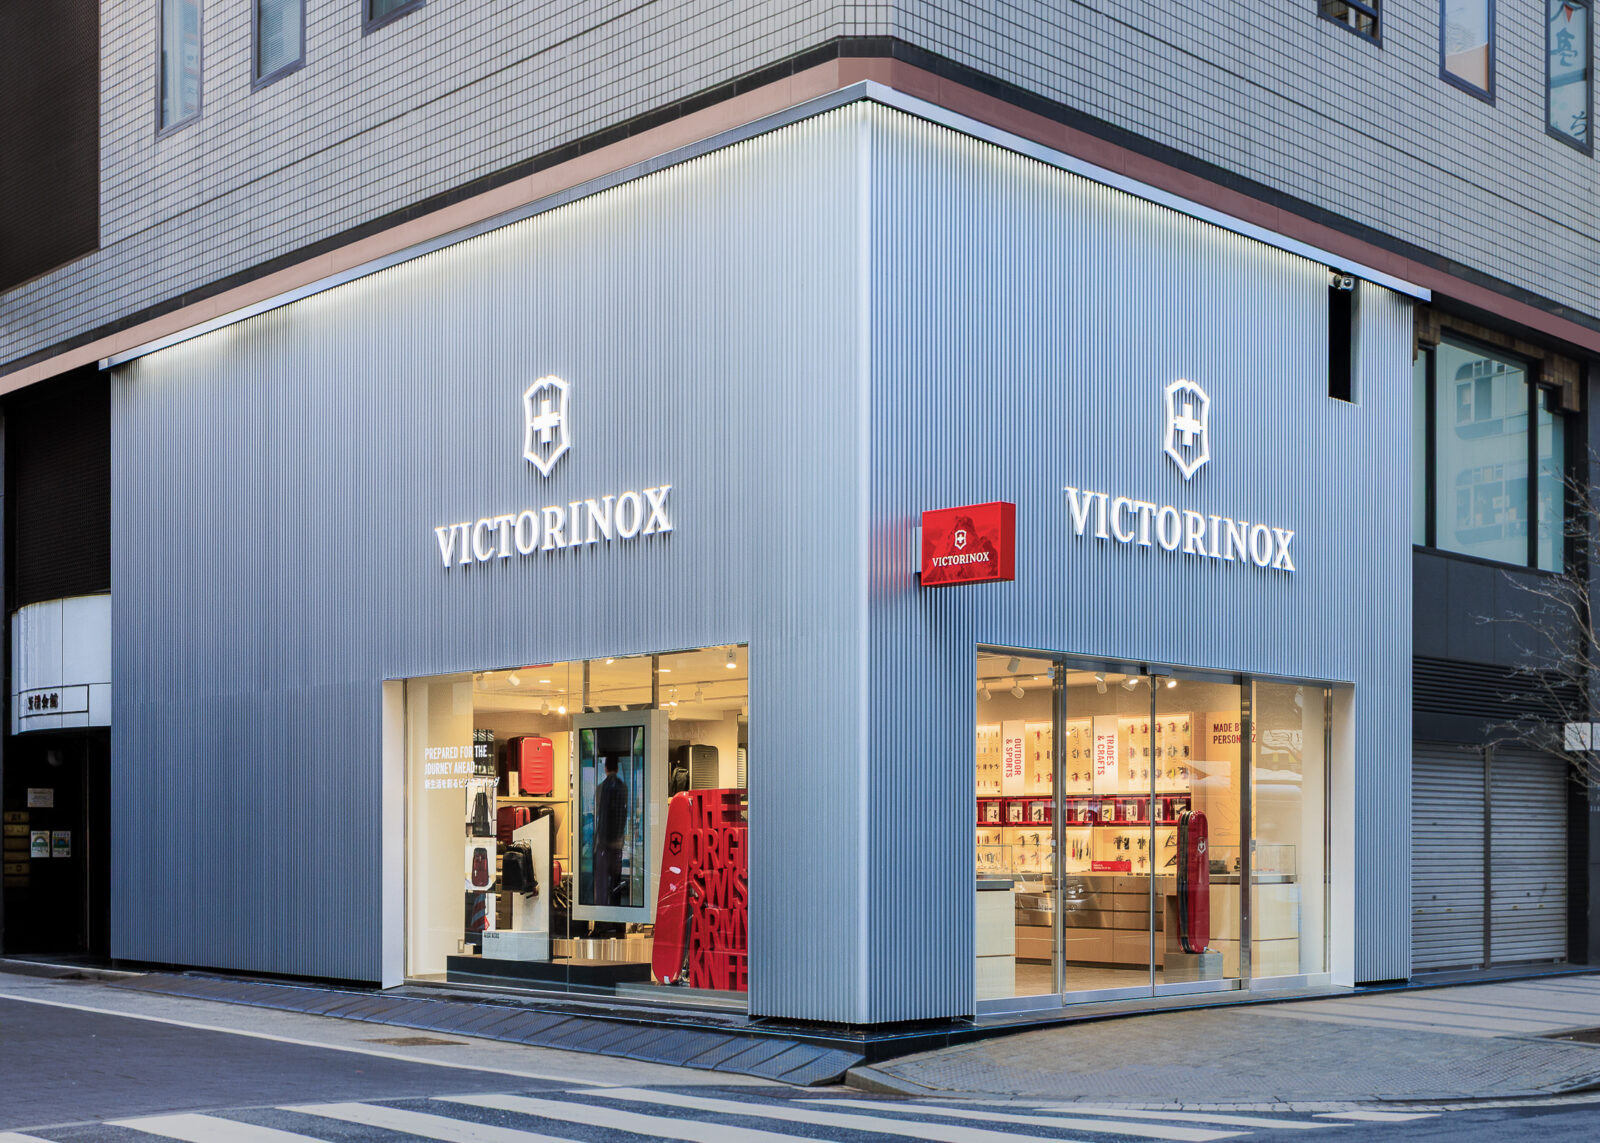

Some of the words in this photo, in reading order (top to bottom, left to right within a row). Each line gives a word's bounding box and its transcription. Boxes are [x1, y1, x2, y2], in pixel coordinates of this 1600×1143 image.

[434, 484, 674, 568] VICTORINOX
[1063, 486, 1295, 572] VICTORINOX
[932, 551, 990, 568] VICTORINOX
[1213, 722, 1233, 733] MADE
[424, 746, 459, 761] PREPARED
[460, 745, 473, 759] FOR
[474, 744, 488, 758] THE
[1005, 748, 1014, 778] SPORTS
[1013, 738, 1022, 776] OUTDOOR
[1096, 745, 1106, 776] CRAFTS
[1106, 734, 1115, 767] TRADES
[424, 762, 453, 775] JOURNEY
[453, 760, 476, 774] AHEAD
[688, 788, 748, 828] THE
[688, 827, 748, 869] ORIGI
